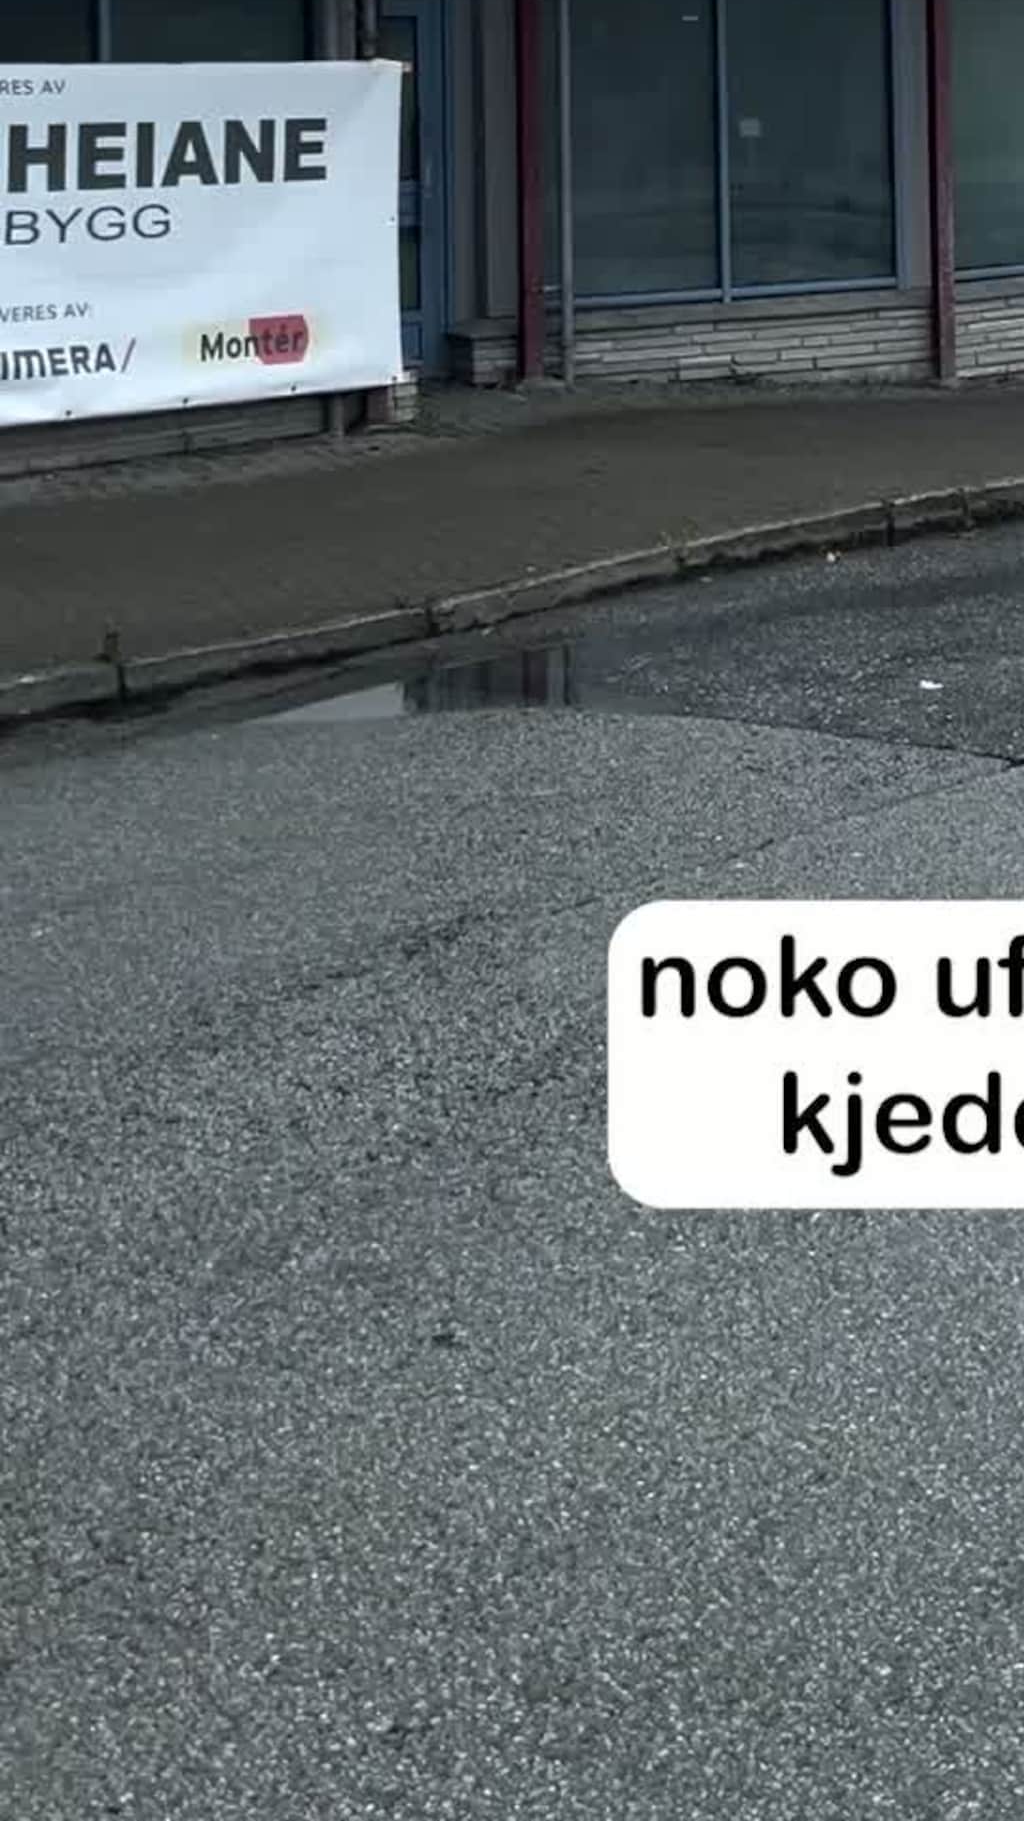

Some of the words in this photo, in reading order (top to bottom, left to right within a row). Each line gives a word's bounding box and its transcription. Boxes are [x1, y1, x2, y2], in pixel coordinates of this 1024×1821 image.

[40, 79, 66, 95] AV
[7, 117, 327, 194] HEIANE
[4, 203, 171, 246] BYGG
